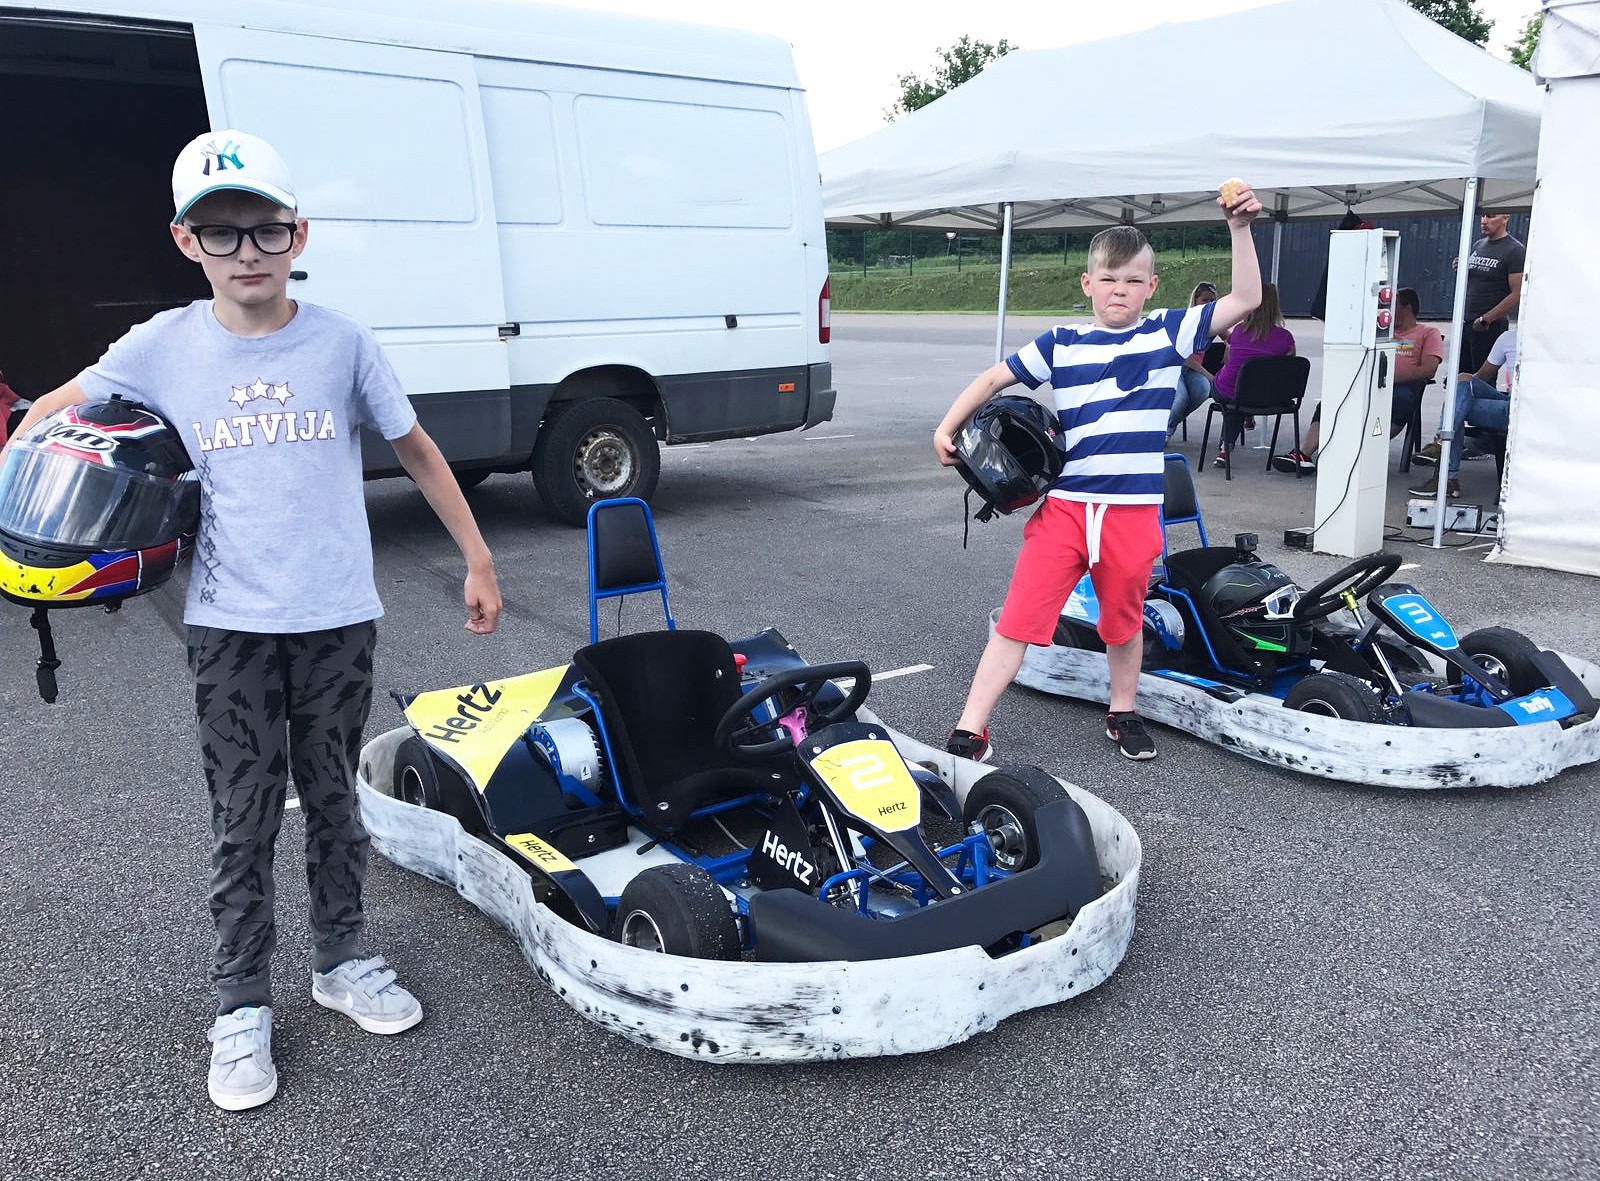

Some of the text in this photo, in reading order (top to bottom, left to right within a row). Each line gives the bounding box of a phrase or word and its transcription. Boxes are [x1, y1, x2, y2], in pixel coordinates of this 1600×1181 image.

[192, 409, 336, 451] LATVIJA
[1398, 602, 1433, 624] 3
[424, 683, 503, 743] Hertz
[841, 754, 893, 792] 2
[877, 801, 907, 817] Hertz
[519, 839, 558, 864] Hertz
[762, 829, 814, 886] Hertz
